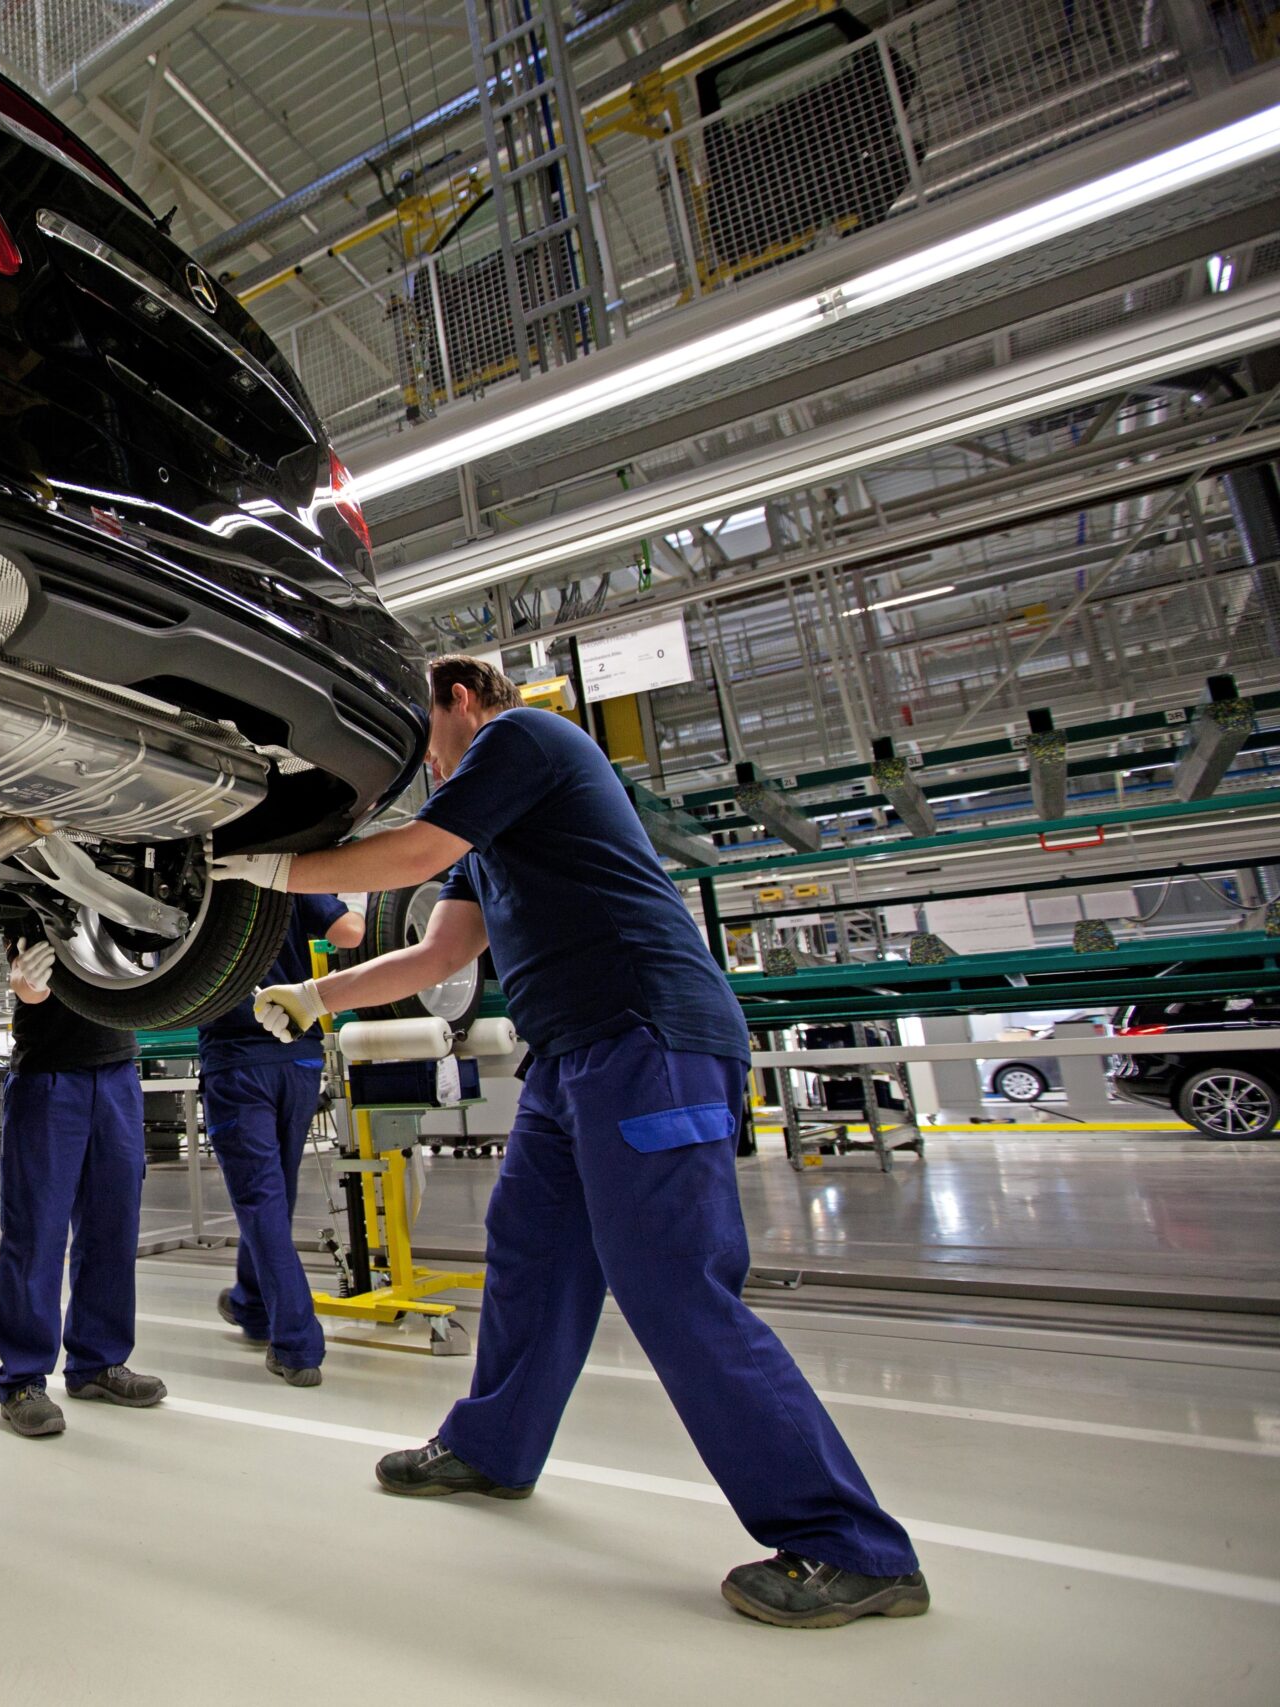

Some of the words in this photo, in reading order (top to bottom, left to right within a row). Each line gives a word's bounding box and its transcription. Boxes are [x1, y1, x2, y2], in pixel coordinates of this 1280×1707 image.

[598, 663, 606, 672] 2
[587, 684, 600, 694] JIS
[1168, 711, 1184, 721] 3R
[908, 758, 919, 766] 3L
[783, 779, 794, 787] 2L
